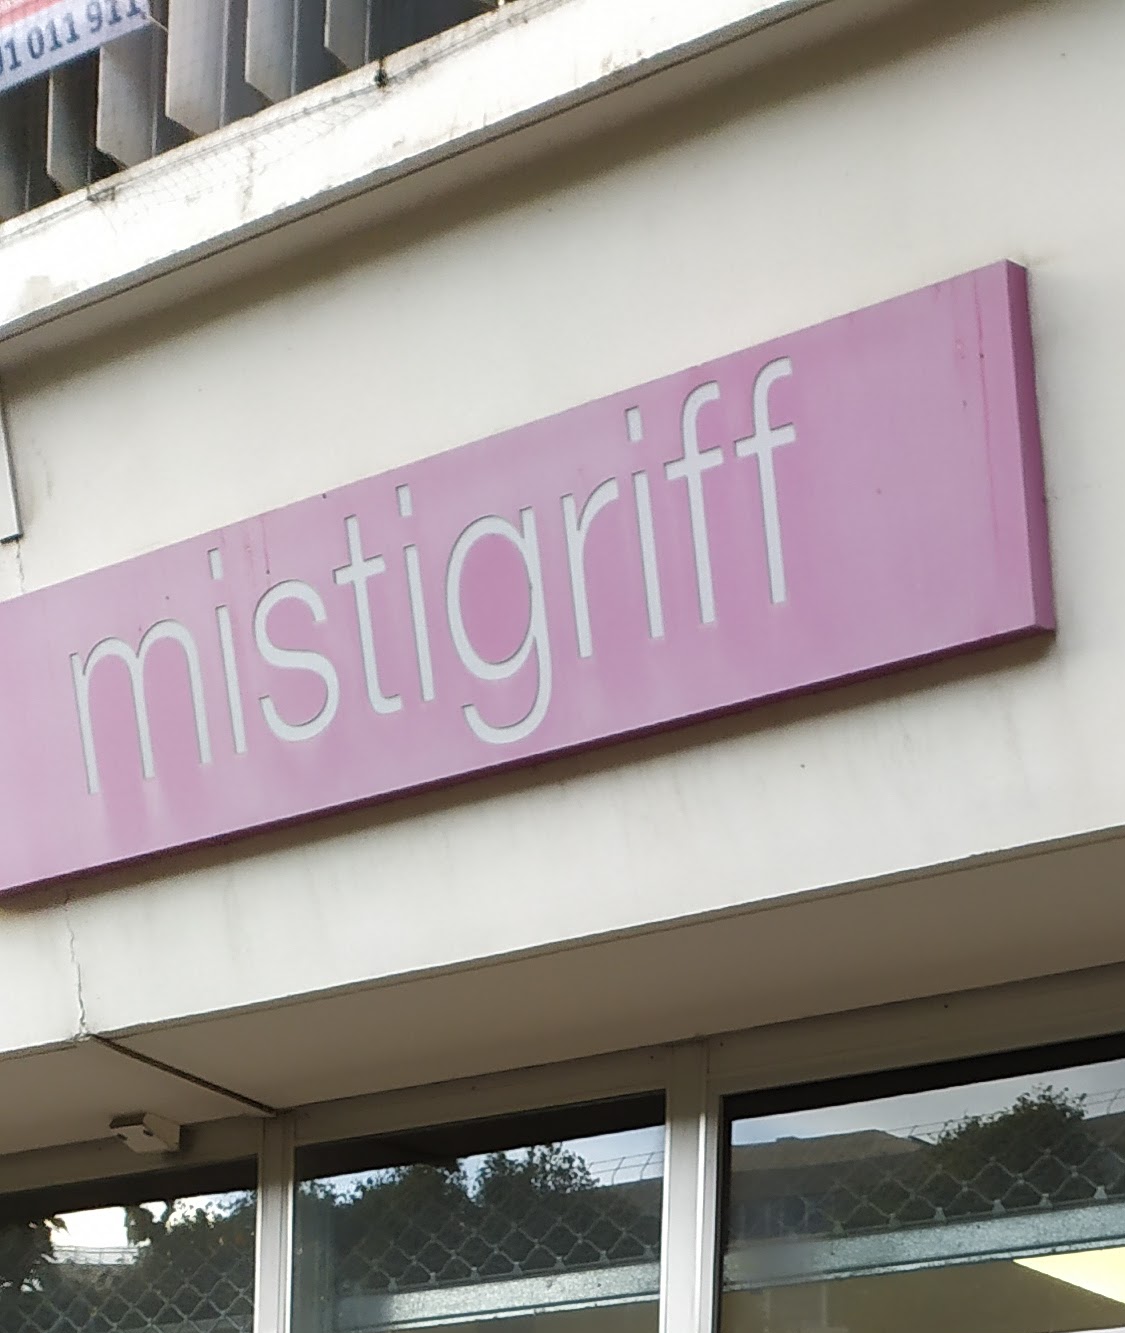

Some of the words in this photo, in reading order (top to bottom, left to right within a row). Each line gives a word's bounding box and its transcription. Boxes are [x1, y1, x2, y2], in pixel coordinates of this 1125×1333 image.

[0, 37, 21, 76] 1
[27, 12, 80, 60] 011
[69, 356, 797, 796] mistigriff
